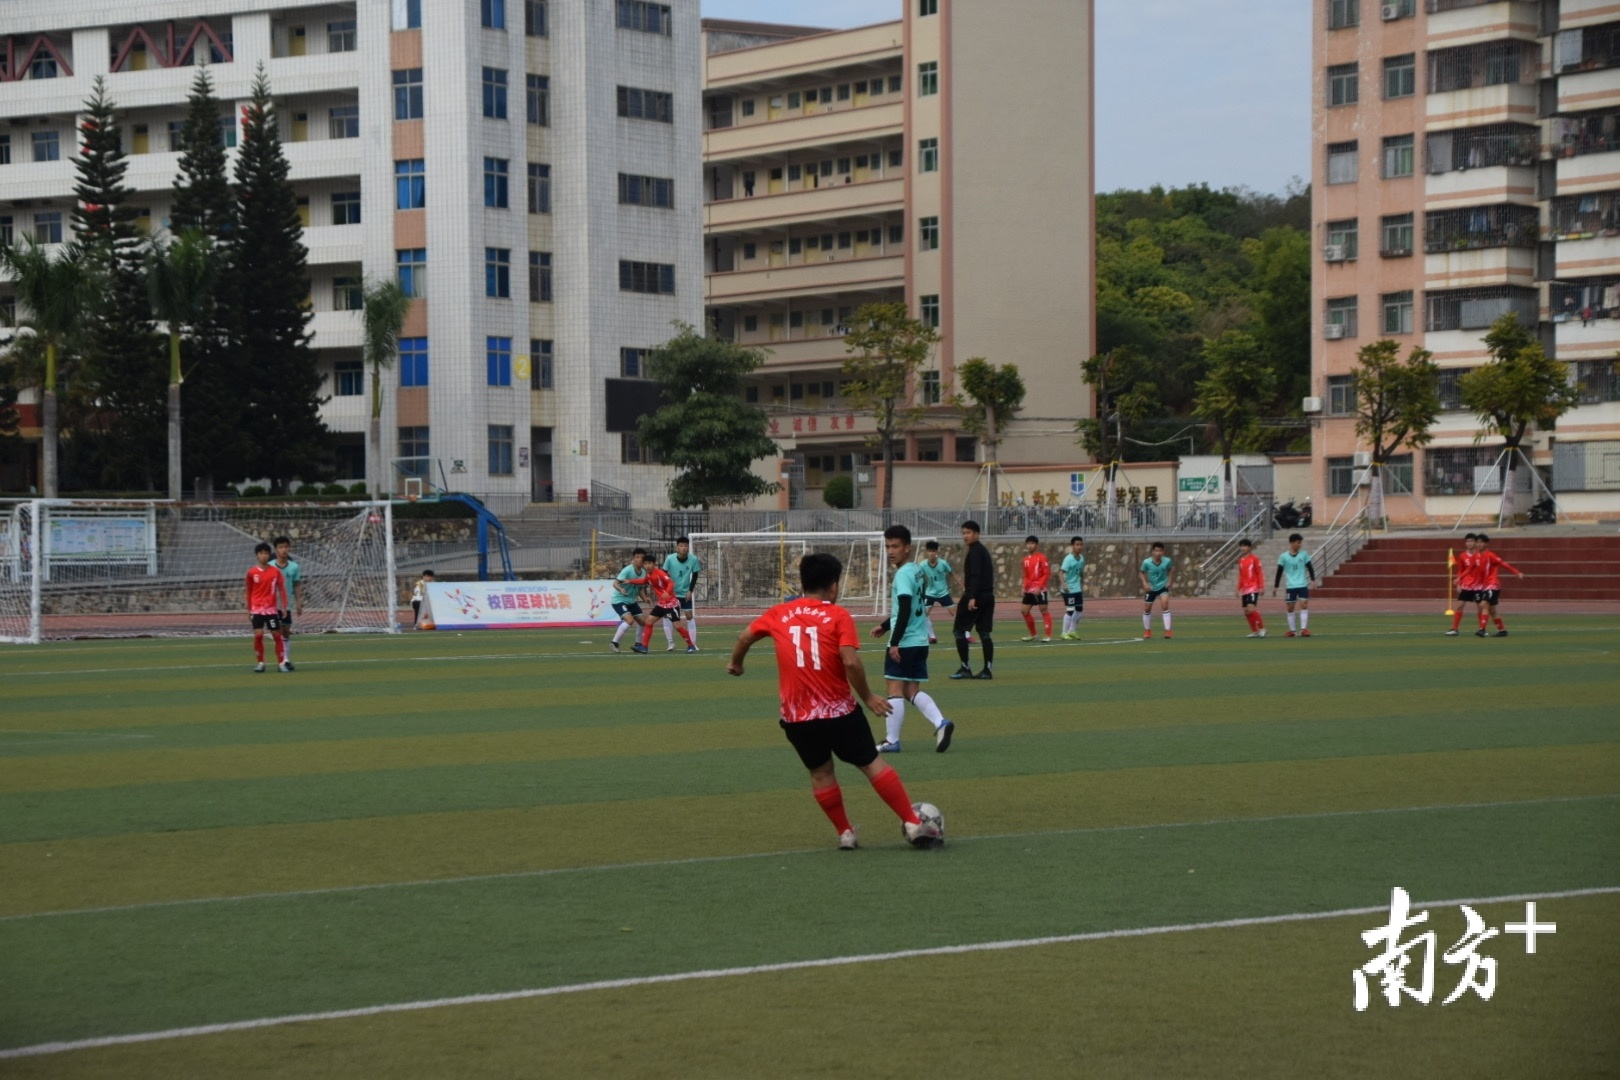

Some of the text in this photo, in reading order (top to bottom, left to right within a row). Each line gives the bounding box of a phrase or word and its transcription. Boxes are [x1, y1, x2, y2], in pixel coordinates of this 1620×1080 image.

[517, 358, 527, 377] 2
[793, 415, 817, 432] 诚信
[830, 413, 855, 430] 友善
[487, 593, 572, 611] 校园足球比赛
[788, 625, 821, 671] 11
